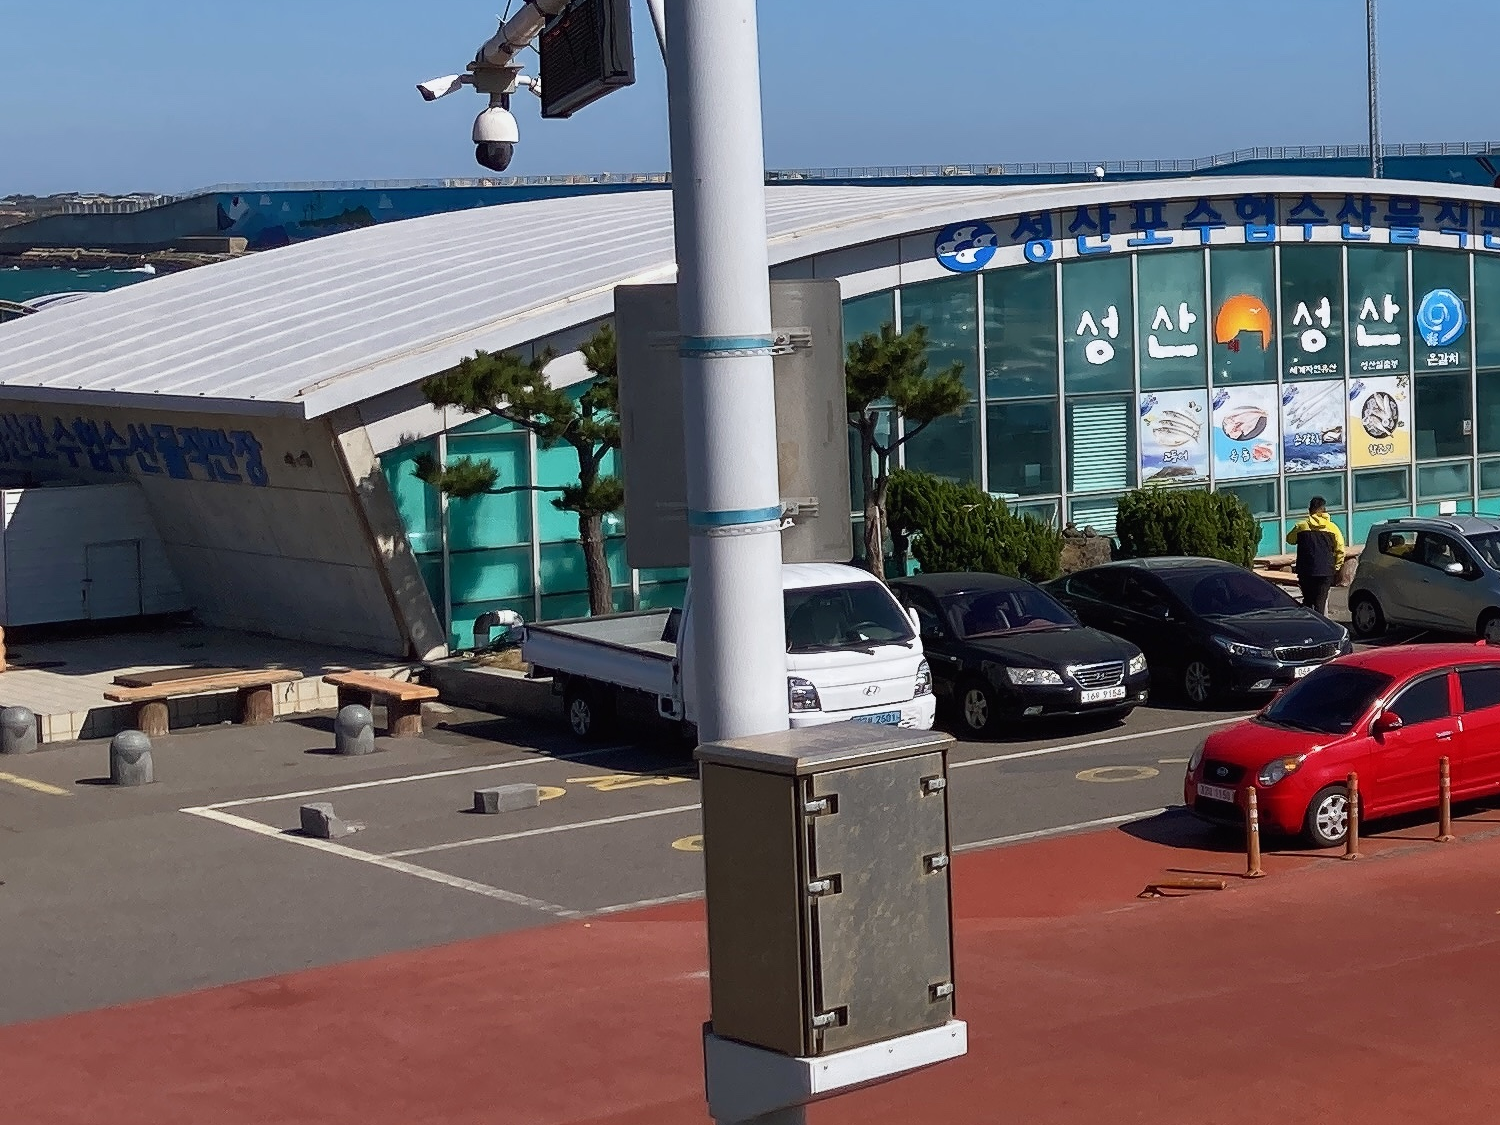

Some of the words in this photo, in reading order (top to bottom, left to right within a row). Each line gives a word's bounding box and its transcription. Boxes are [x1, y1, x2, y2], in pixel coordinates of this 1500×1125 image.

[1075, 302, 1199, 365] 성산
[1292, 293, 1401, 353] 성산
[1289, 362, 1338, 375] 세계자연유산
[1163, 449, 1189, 464] 고등어
